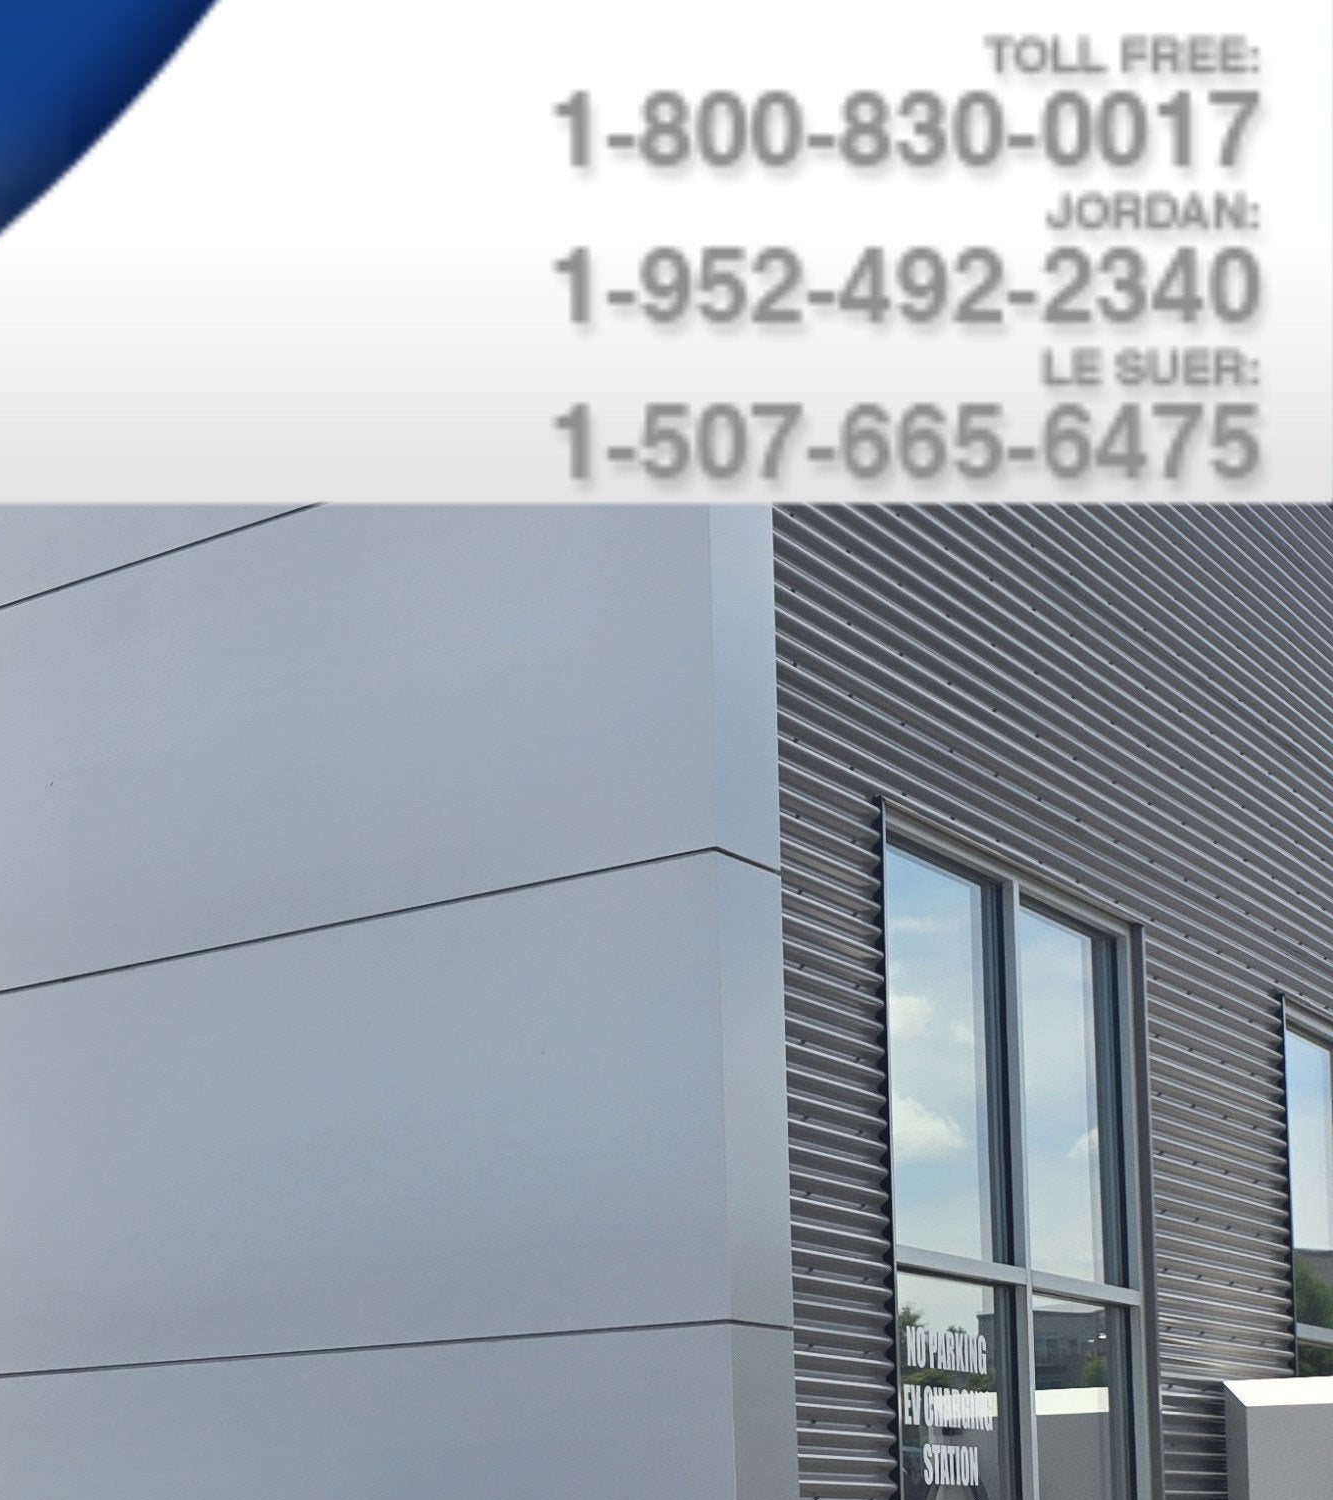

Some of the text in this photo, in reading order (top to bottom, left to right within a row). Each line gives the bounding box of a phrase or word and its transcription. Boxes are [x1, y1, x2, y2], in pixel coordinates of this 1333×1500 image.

[906, 1326, 987, 1375] NO PARKING
[904, 1384, 921, 1425] EV
[923, 1444, 979, 1487] STATION
